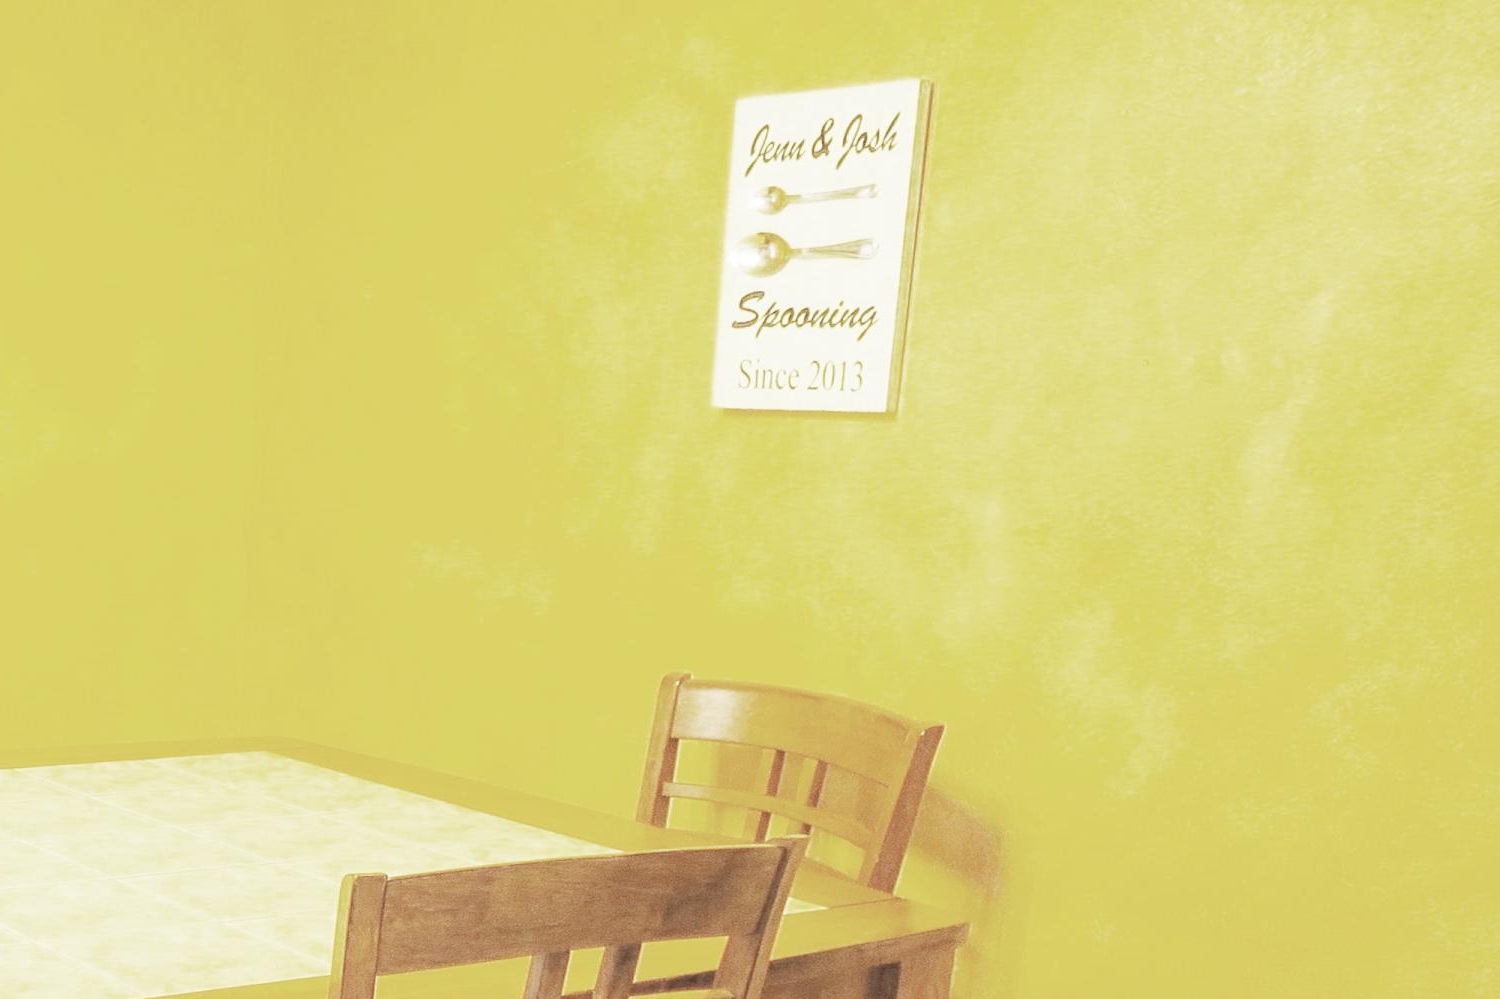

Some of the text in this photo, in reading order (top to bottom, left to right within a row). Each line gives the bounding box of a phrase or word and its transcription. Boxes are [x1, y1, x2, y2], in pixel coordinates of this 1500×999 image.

[745, 112, 900, 177] Jenn & Josh
[731, 290, 878, 342] Spooning
[738, 359, 864, 392] Since 2013
